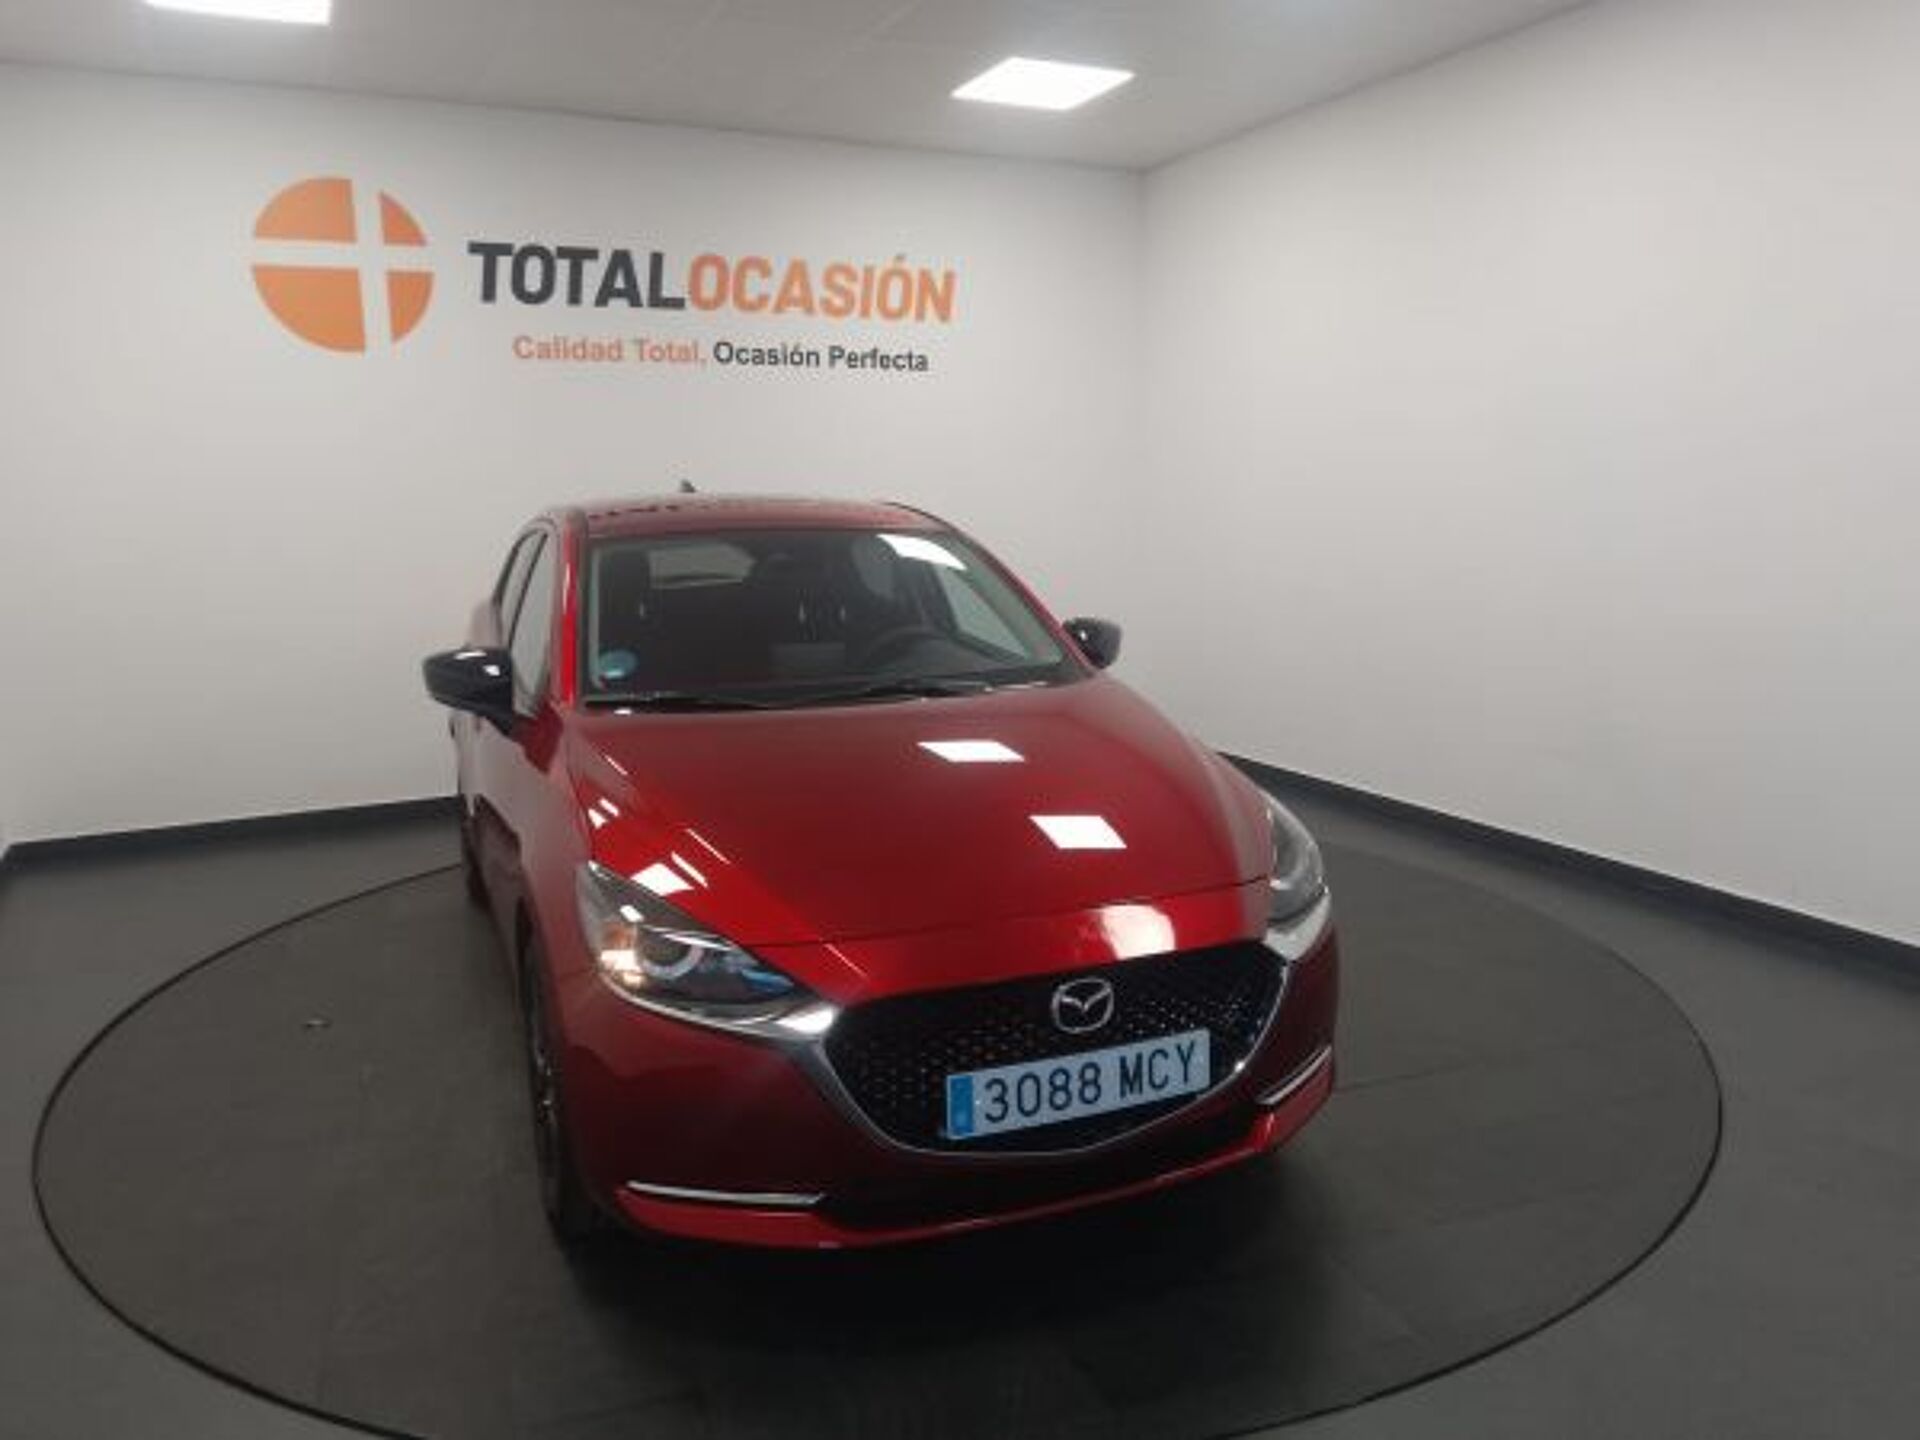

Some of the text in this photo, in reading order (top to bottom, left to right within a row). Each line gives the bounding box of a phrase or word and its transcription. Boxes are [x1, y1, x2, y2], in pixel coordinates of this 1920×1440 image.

[513, 335, 623, 362] Calidad
[713, 341, 820, 368] Ocasión
[828, 346, 929, 372] Perfecta
[985, 1041, 1195, 1122] 3088 MCY
